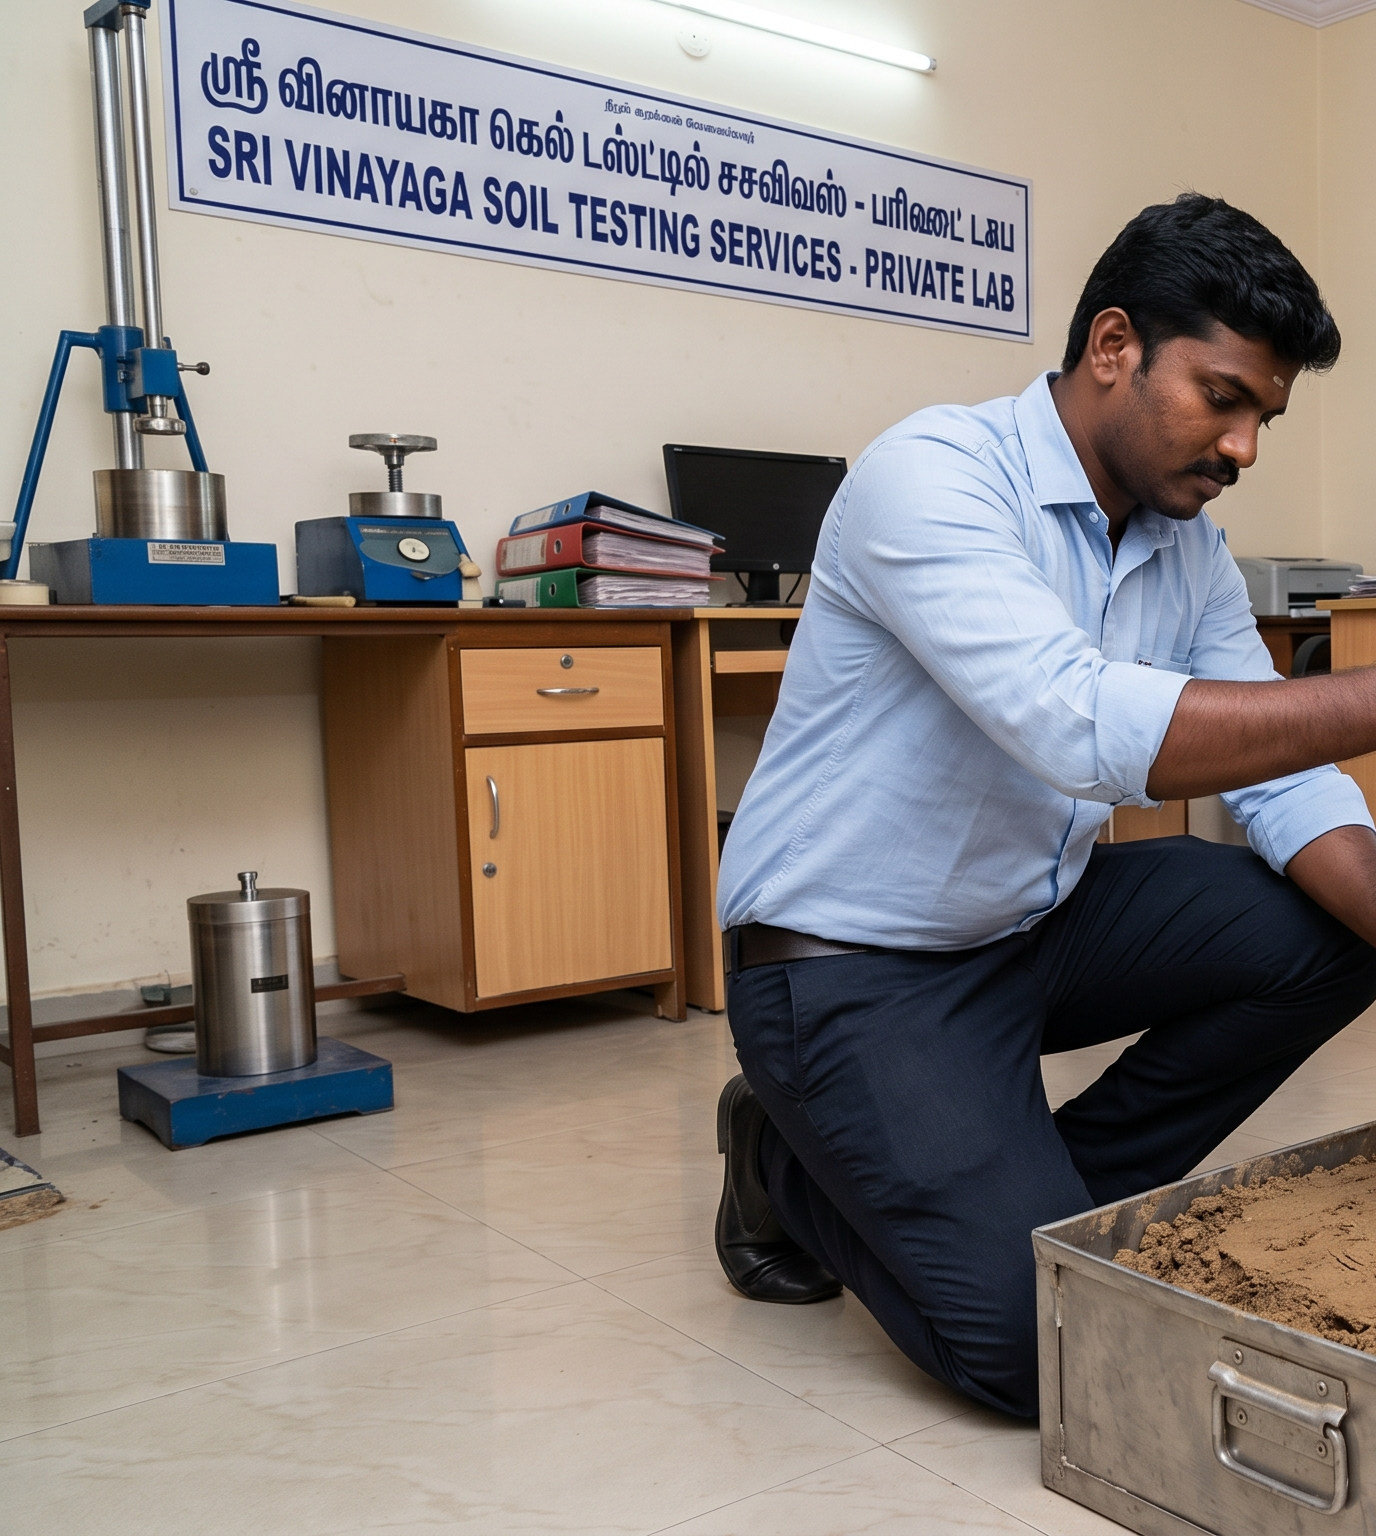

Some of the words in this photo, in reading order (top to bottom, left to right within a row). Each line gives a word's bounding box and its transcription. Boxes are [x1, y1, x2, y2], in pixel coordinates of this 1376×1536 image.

[201, 38, 268, 115] ஸ்ரீ
[208, 126, 272, 186] SRI
[284, 138, 473, 220] VINAYAGA
[484, 176, 559, 235] SOIL
[569, 191, 701, 259] TESTING
[711, 218, 842, 283] SERVICES
[866, 247, 965, 305] PRIVATE
[973, 268, 1015, 313] LAB
